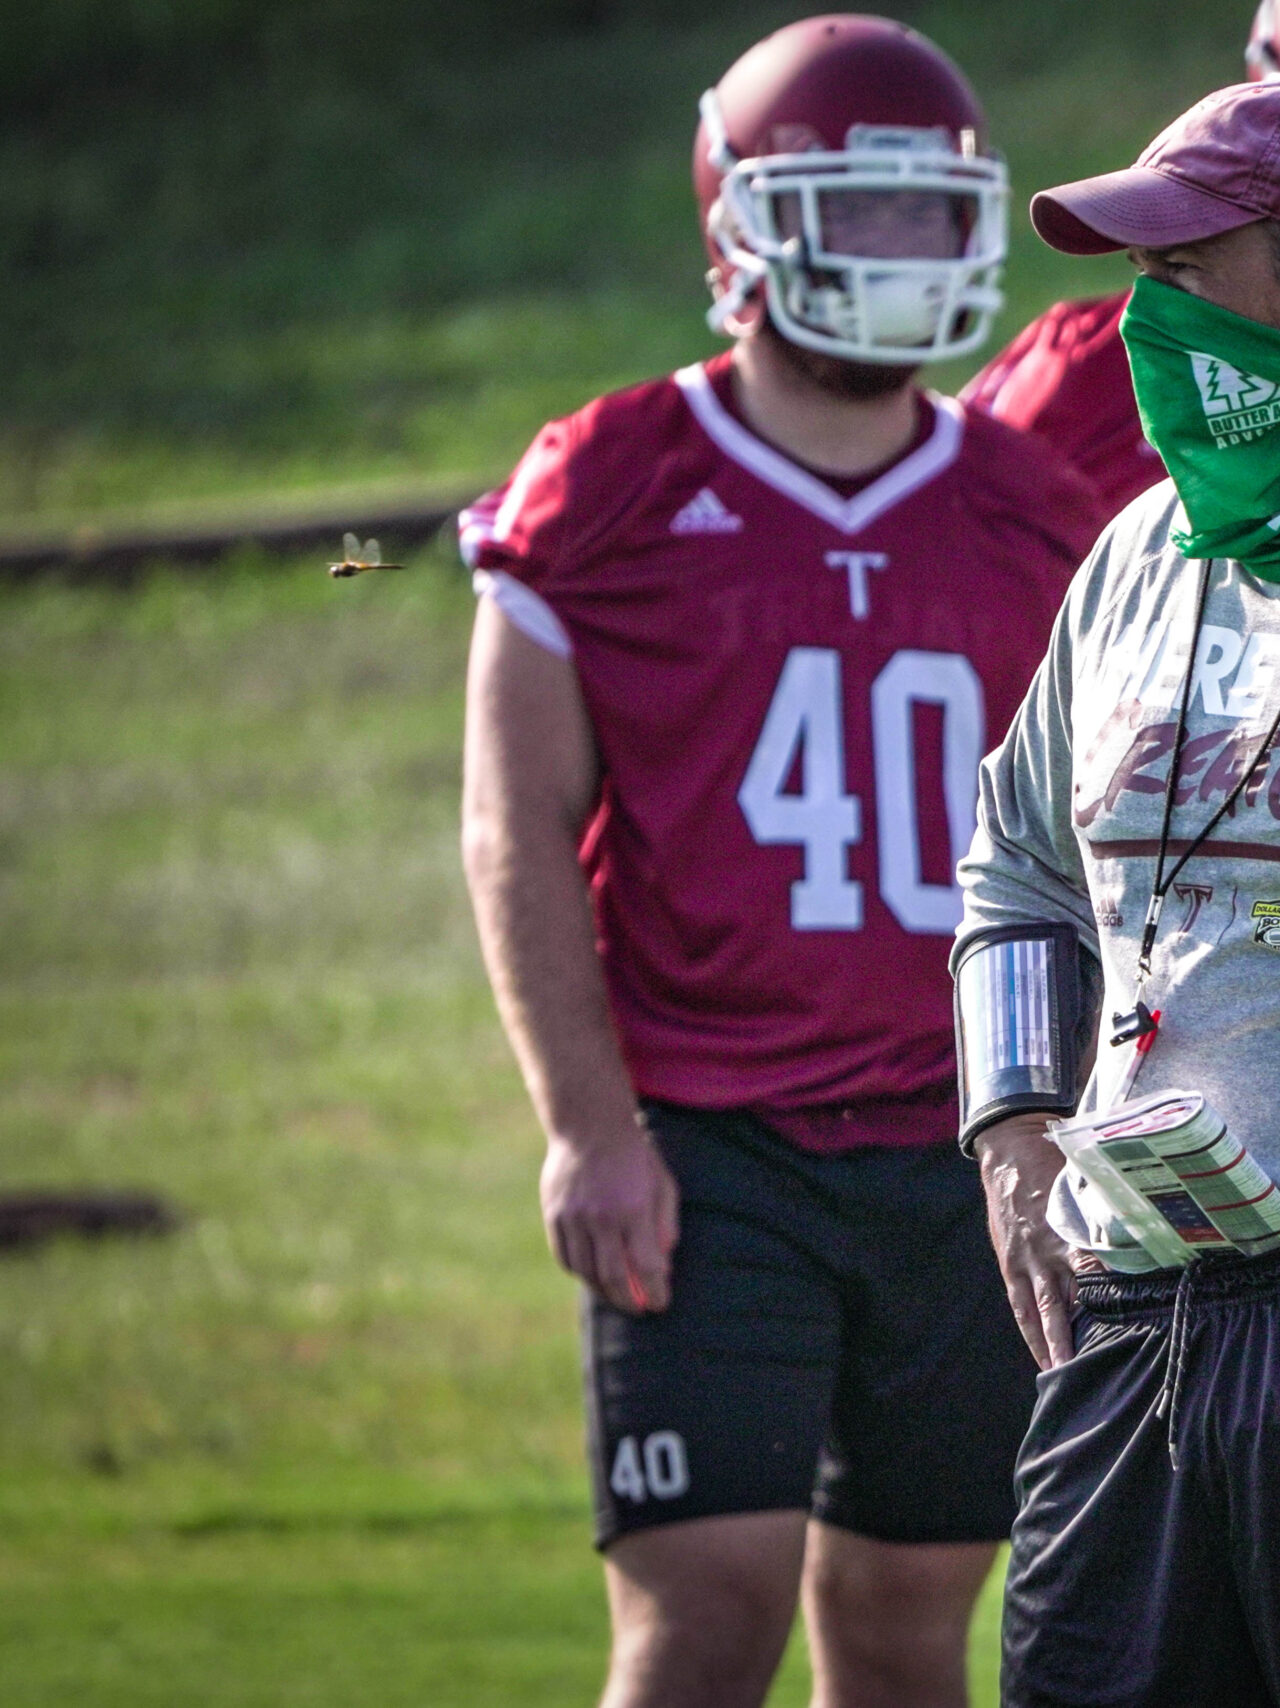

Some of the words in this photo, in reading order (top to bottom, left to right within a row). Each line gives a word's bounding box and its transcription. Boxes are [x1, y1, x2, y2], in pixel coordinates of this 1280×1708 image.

[1210, 408, 1271, 434] BUTTER
[824, 549, 889, 620] T
[737, 646, 986, 935] 40
[610, 1430, 689, 1503] 40
